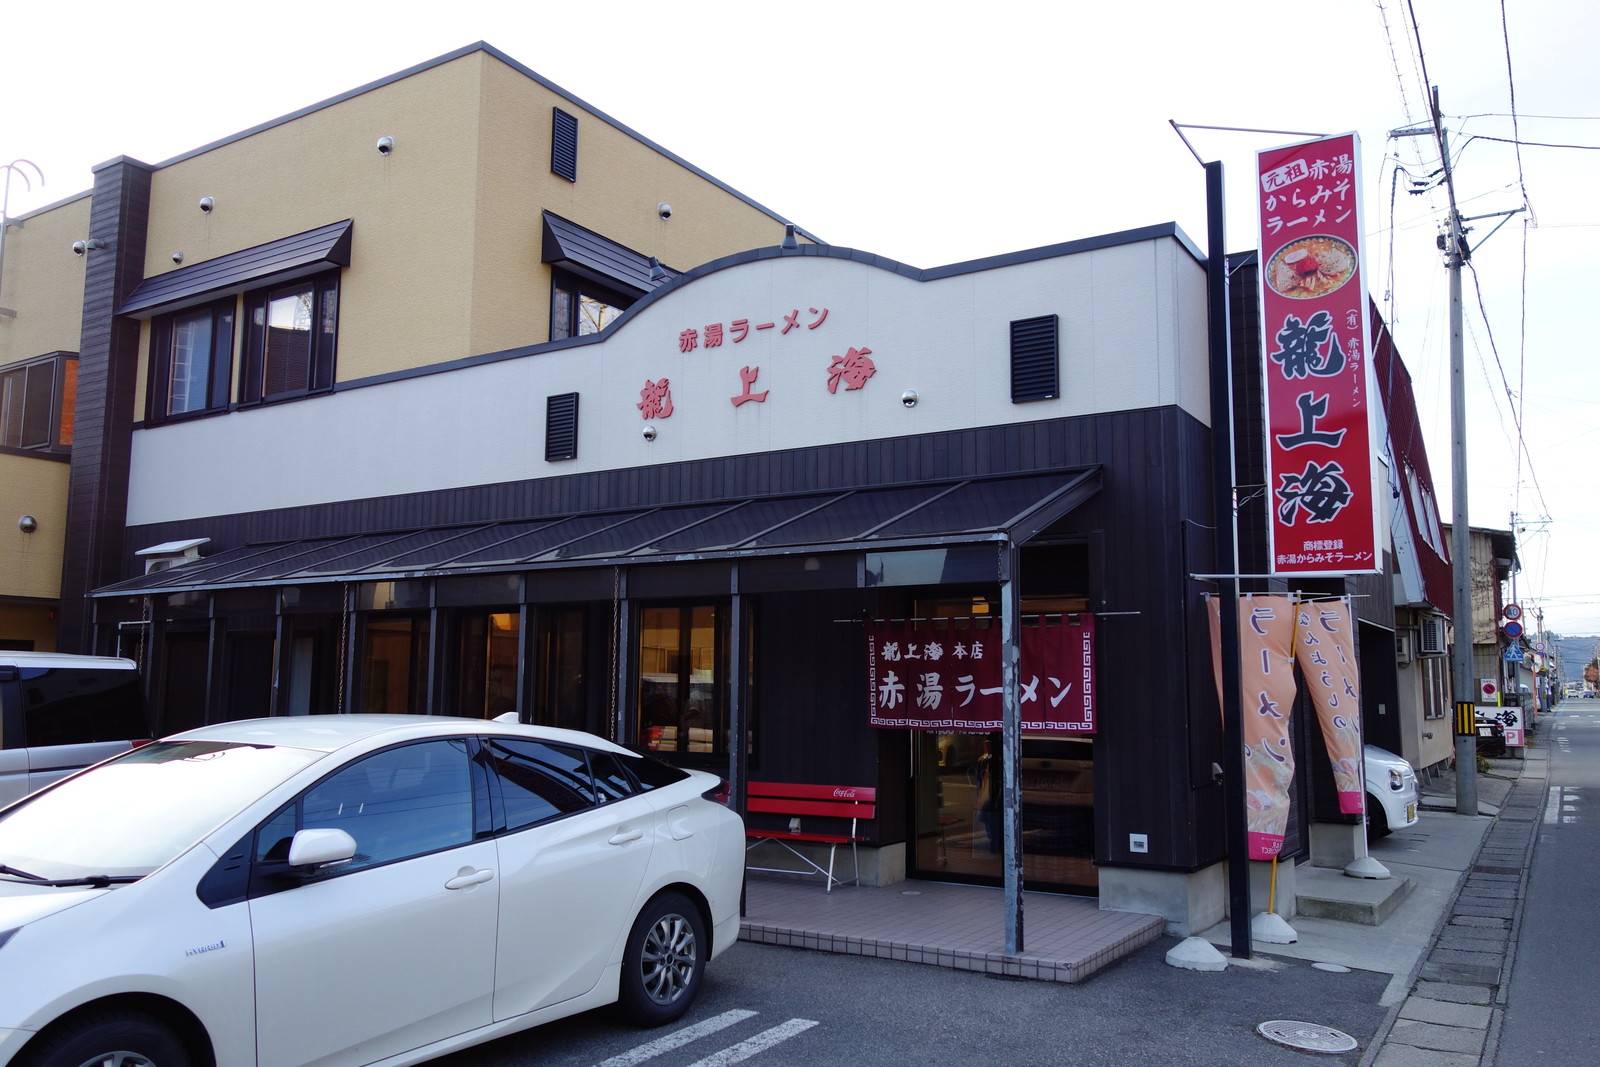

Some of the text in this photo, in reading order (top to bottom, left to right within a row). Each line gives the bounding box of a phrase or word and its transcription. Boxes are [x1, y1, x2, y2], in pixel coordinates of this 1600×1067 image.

[1266, 153, 1353, 190] 元祖 赤湯
[1265, 178, 1350, 212] からみそ
[1266, 205, 1352, 235] ラーメン
[678, 307, 829, 353] 赤湯ラーメン
[637, 346, 877, 420] 龍上海
[1347, 337, 1361, 408] 赤湯ラーメン
[1270, 311, 1354, 527] 龍上海
[1276, 551, 1373, 565] 赤湯からみそラーメン
[1303, 539, 1343, 551] 商標登録
[881, 641, 984, 662] 龍上海 本店
[879, 670, 1073, 711] 赤湯ラーメン
